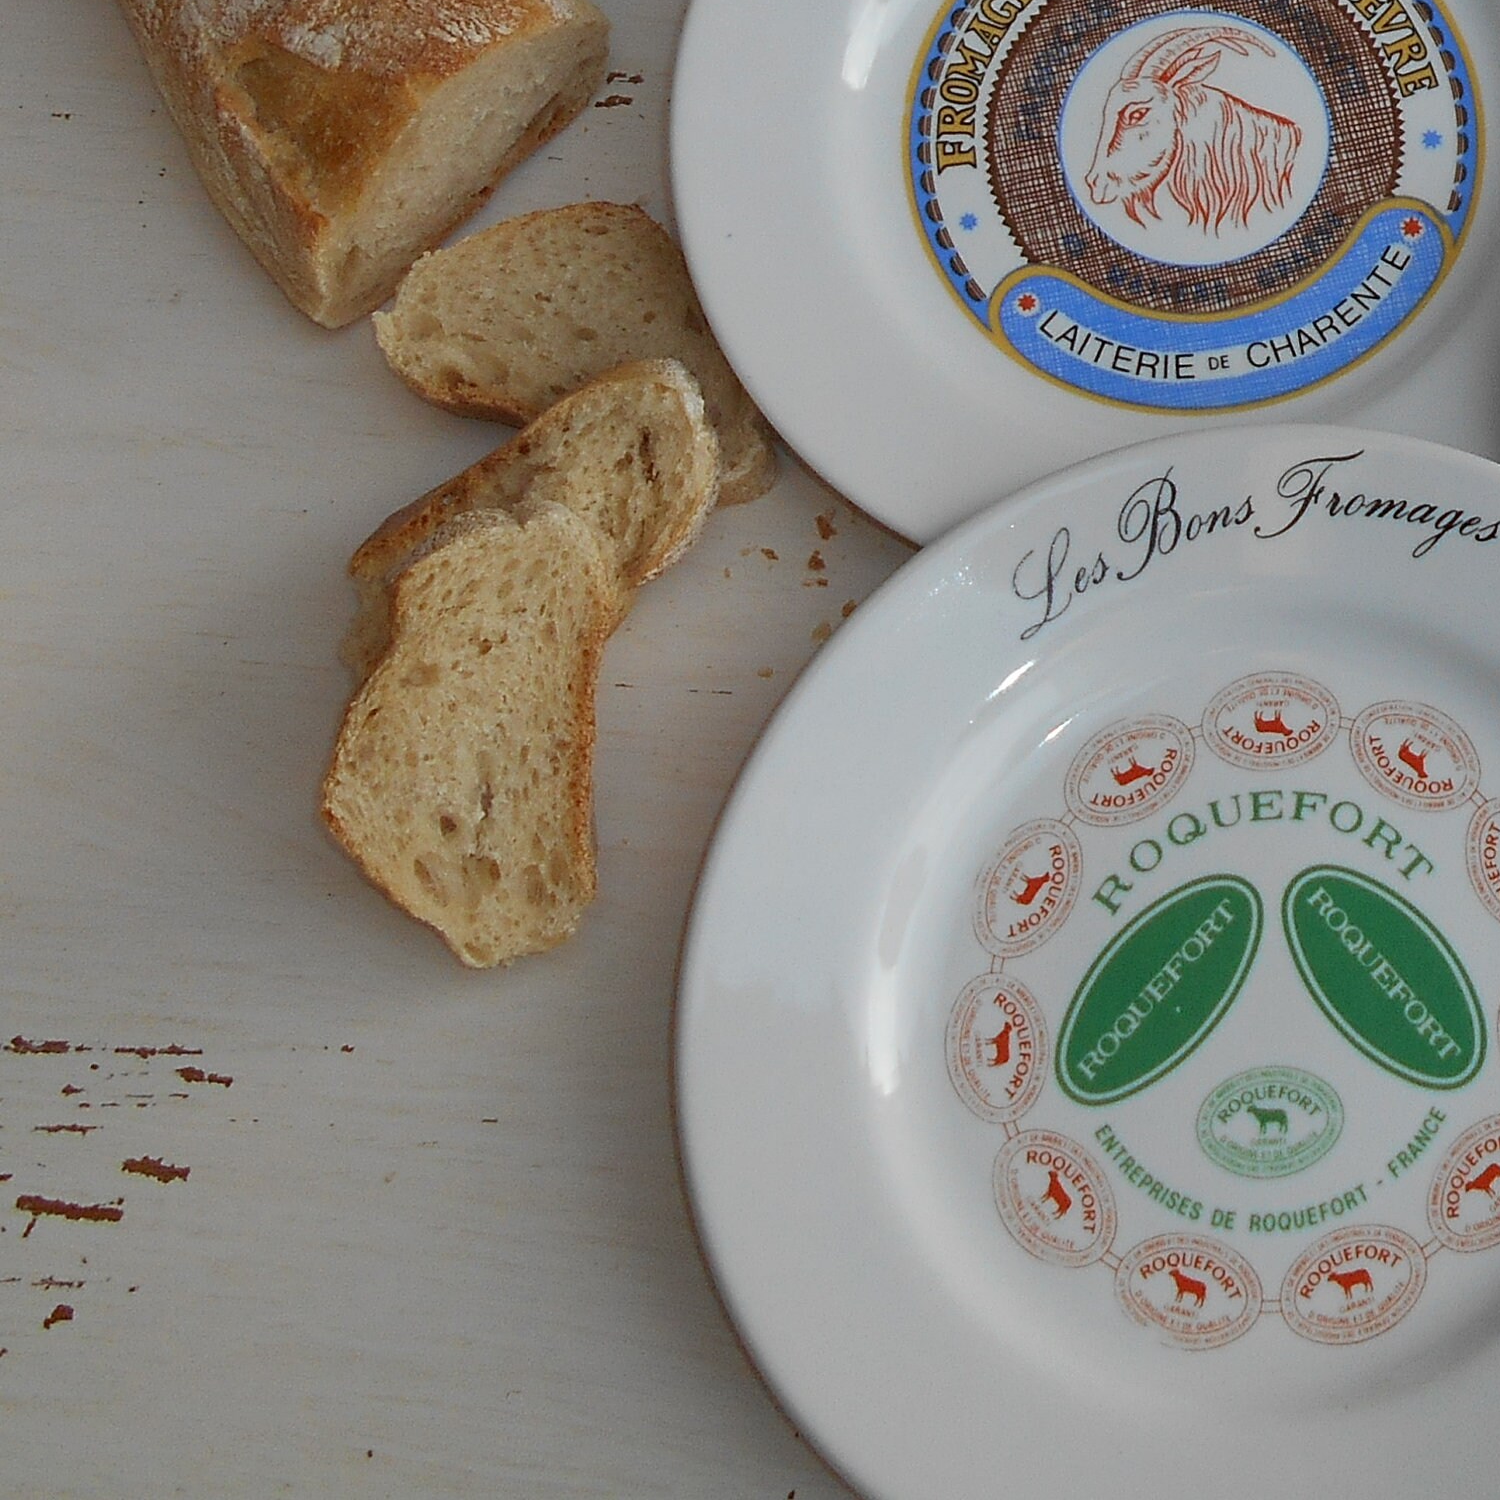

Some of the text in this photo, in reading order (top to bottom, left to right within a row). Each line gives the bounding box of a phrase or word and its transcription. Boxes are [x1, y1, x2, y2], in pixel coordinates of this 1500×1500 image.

[1039, 245, 1411, 380] LAITERIE DE CHARENTE
[1012, 527, 1109, 640] Les
[1117, 466, 1255, 581] Bons
[1091, 748, 1178, 808] ROQUEFORT
[1222, 719, 1320, 754] ROQUEFORT
[1369, 734, 1454, 793] ROQUEFORT
[1007, 845, 1065, 938] ROQUEFORT
[1093, 789, 1433, 915] ROQUEFORT
[1079, 897, 1240, 1080] ROQUEFORT
[1306, 886, 1461, 1065] ROQUEFORT
[993, 992, 1033, 1100] ROQUEFORT
[1217, 1085, 1322, 1124] ROQUEFORT
[1026, 1149, 1096, 1235] ROQUEFORT
[1095, 1122, 1204, 1220] ENTREPRISES
[1211, 1208, 1237, 1230] DE
[1250, 1184, 1367, 1233] ROQUEFORT
[1388, 1106, 1447, 1178] FRANCE
[1139, 1252, 1243, 1300] ROQUEFORT
[1300, 1245, 1403, 1300] ROQUEFORT
